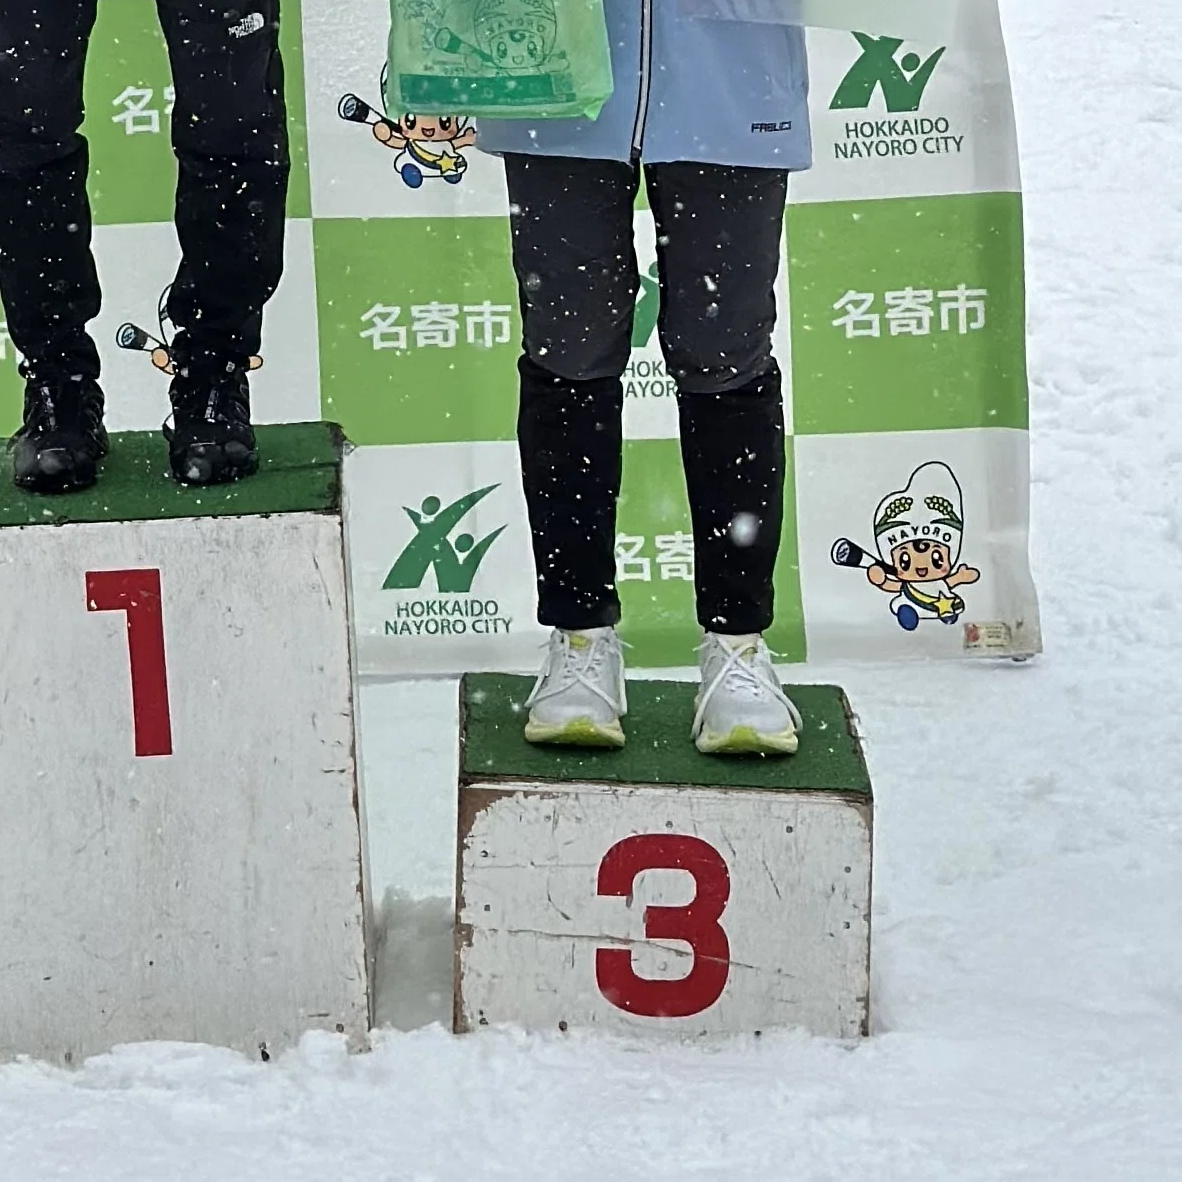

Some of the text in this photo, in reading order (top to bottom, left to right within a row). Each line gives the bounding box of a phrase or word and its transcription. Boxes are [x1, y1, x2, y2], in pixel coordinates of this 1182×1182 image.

[845, 117, 949, 139] HOKKAIDO
[835, 135, 964, 159] NAYORO CITY
[832, 283, 987, 339] 名寄市
[359, 300, 511, 352] 名寄市
[625, 381, 677, 398] AYOR
[887, 524, 952, 545] NAYORO
[616, 533, 694, 581] 名寄
[396, 600, 499, 618] HOKKAIDO
[385, 617, 511, 636] NAYORO CITY
[87, 567, 173, 756] 1
[595, 834, 731, 1018] 3
